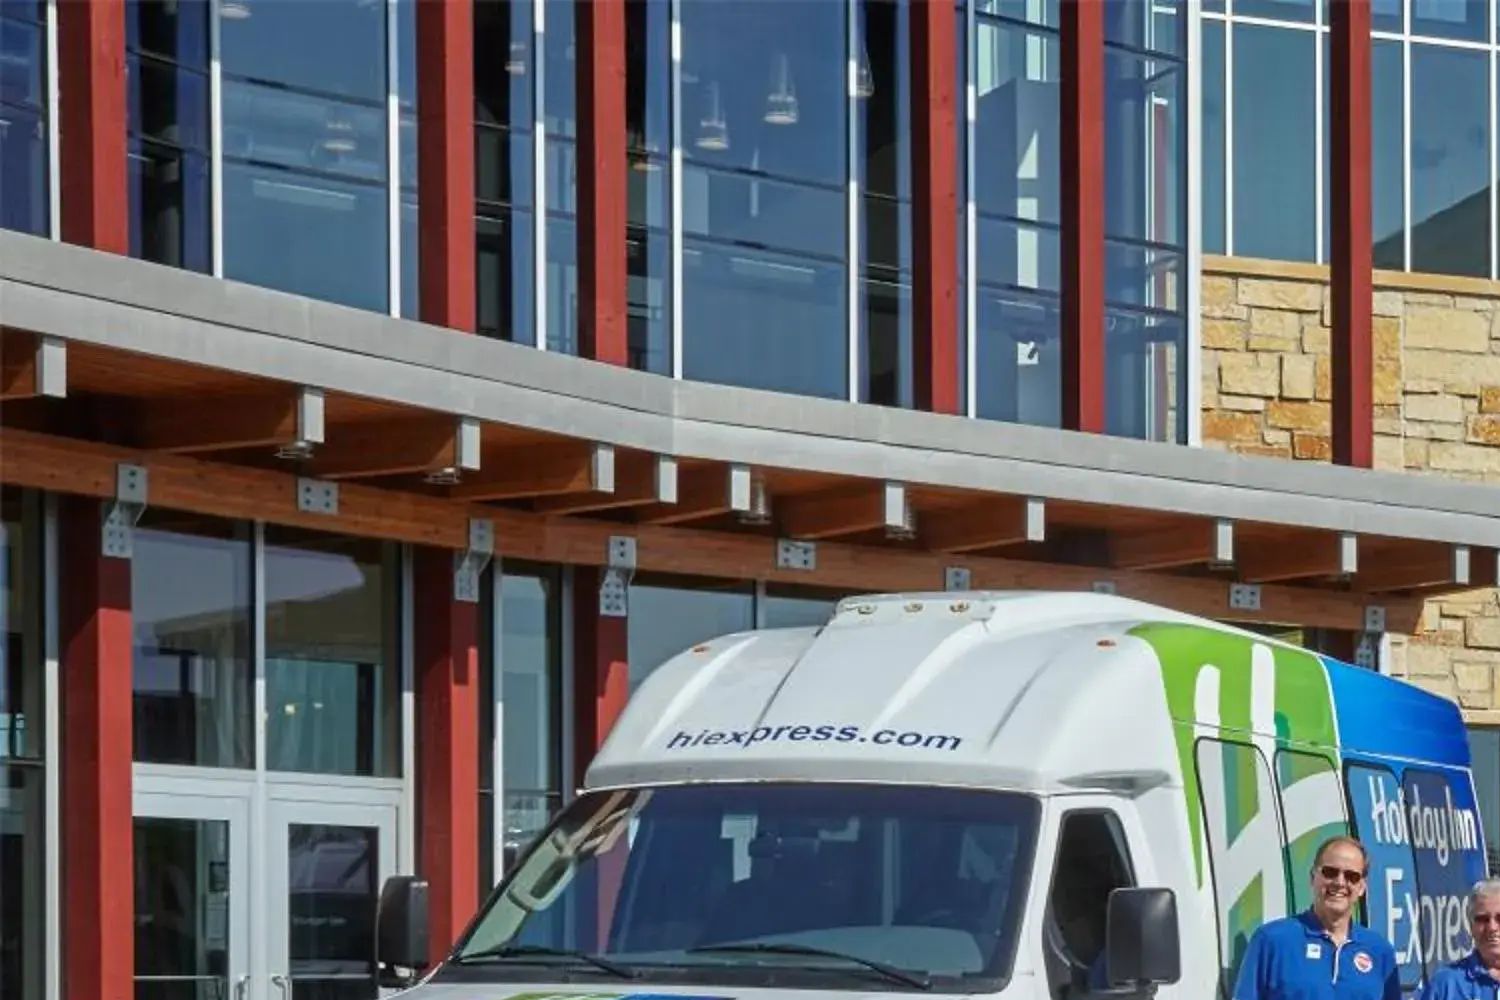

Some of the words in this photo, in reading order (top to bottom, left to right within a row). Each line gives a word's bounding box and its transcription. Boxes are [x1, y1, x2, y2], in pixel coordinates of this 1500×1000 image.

[666, 723, 963, 751] hiexpress.com
[1445, 785, 1478, 850] Inn
[1385, 867, 1476, 964] Expres
